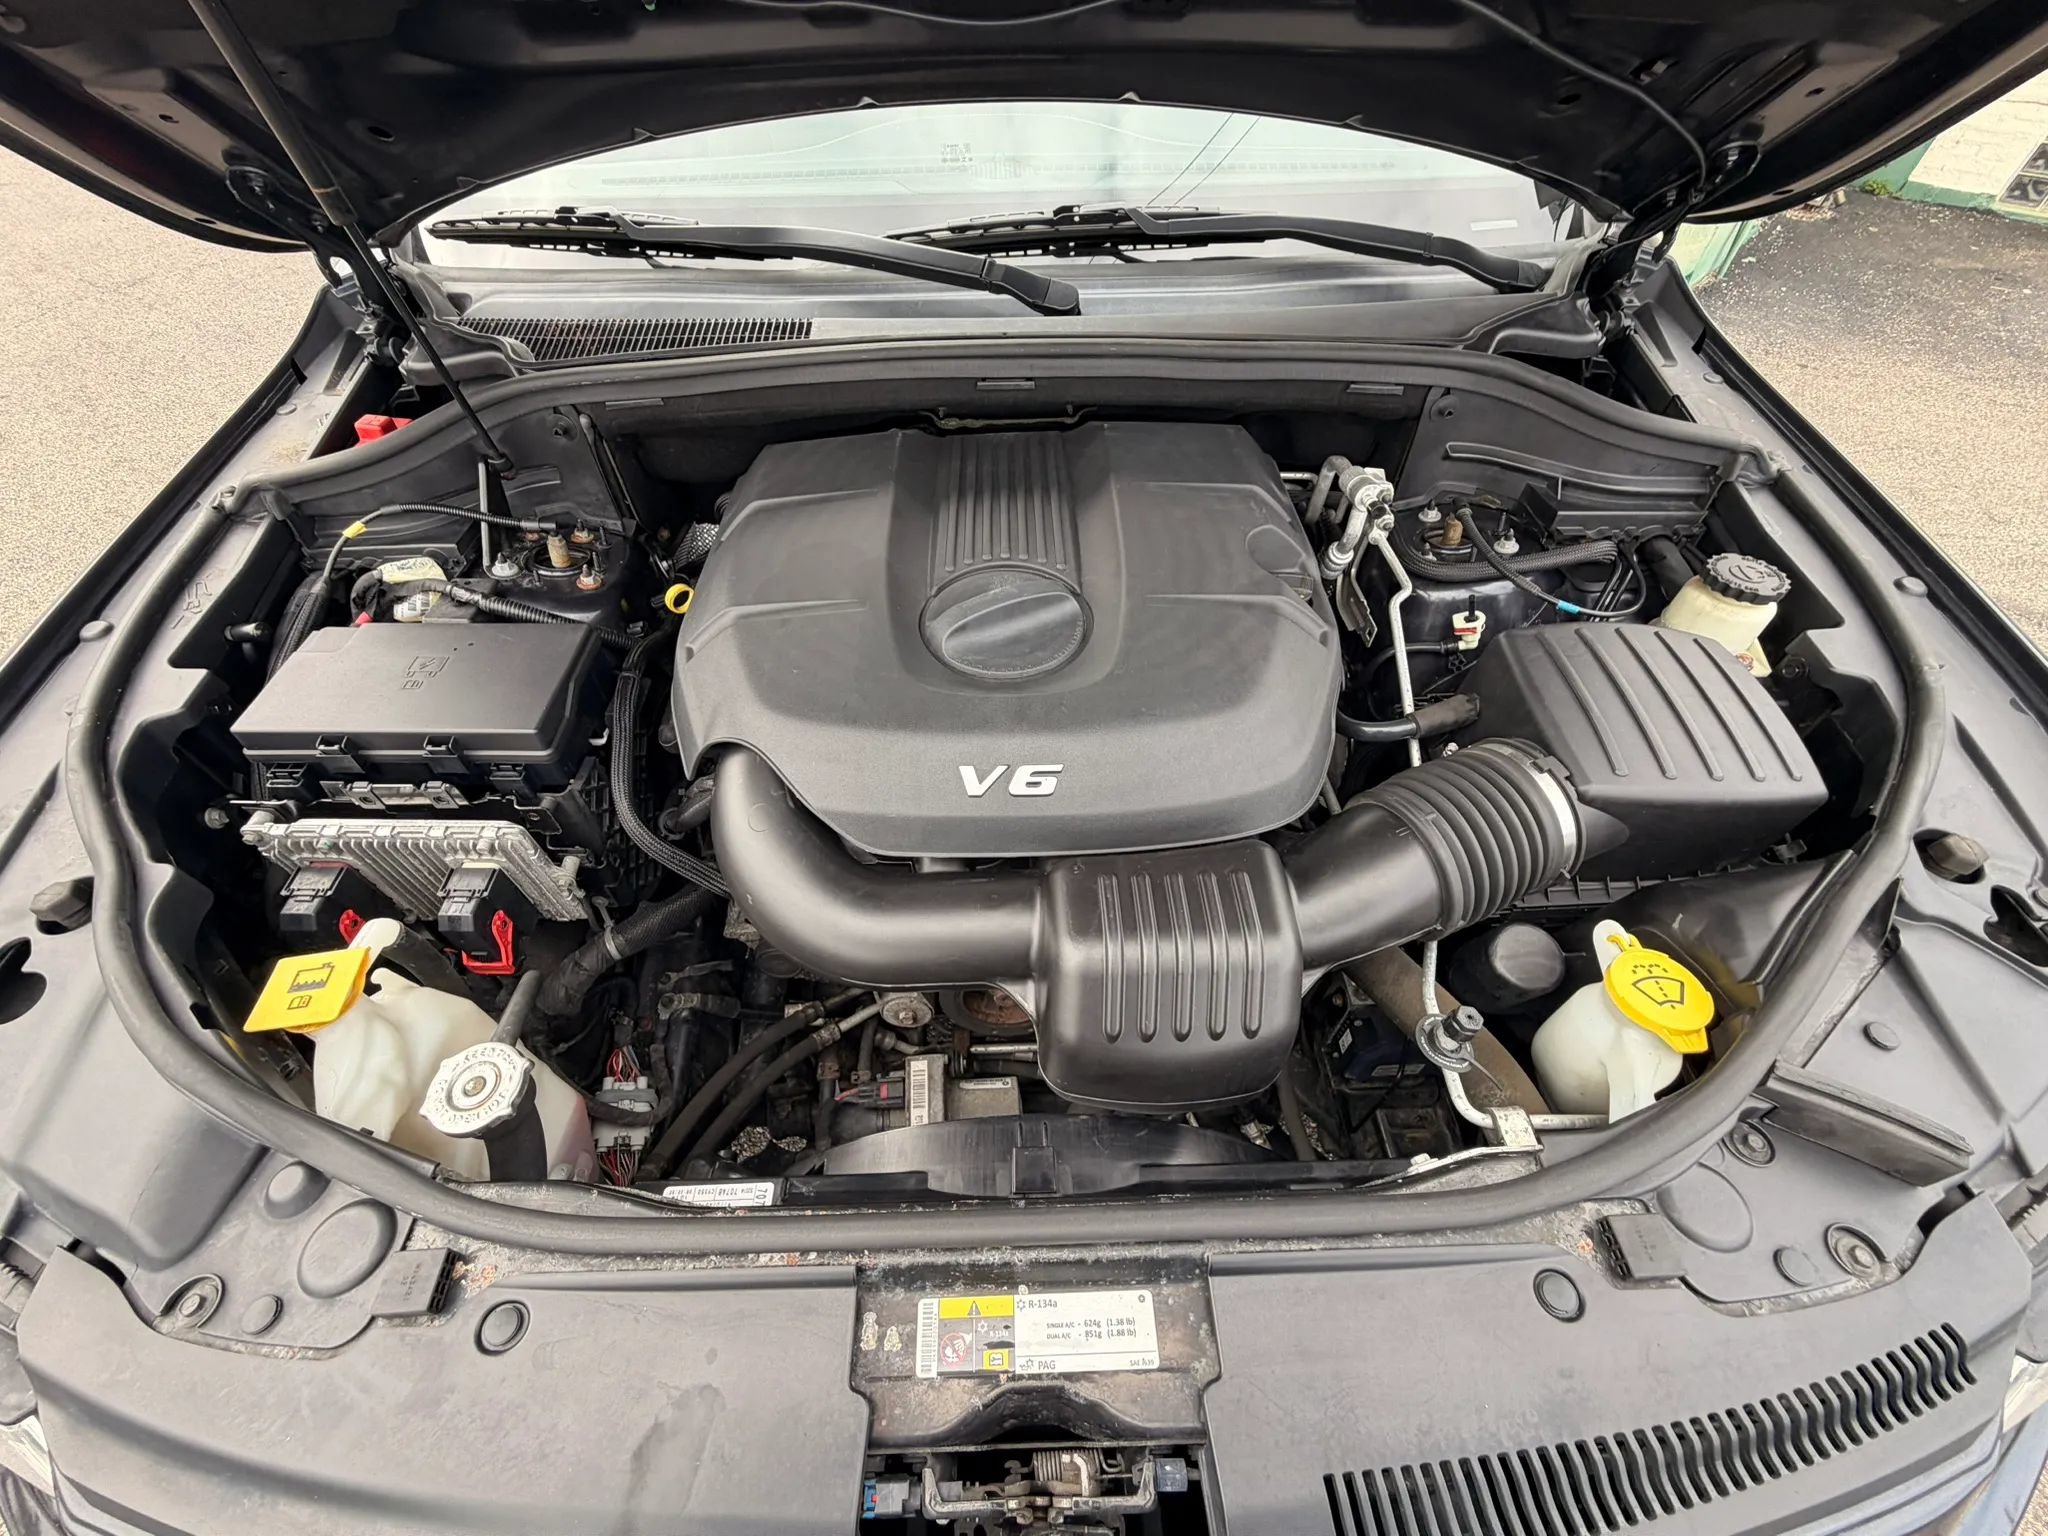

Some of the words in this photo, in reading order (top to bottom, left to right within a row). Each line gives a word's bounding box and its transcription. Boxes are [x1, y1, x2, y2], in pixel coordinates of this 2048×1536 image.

[959, 764, 1065, 798] V6
[1028, 1299, 1058, 1309] R-134a
[1084, 1319, 1101, 1329] 624g
[1106, 1317, 1125, 1327] (1.38
[1126, 1316, 1136, 1327] lb)
[1085, 1329, 1102, 1339] 851g
[1107, 1328, 1126, 1338] (1.88
[1127, 1327, 1137, 1338] lb)
[1038, 1360, 1056, 1370] PAG
